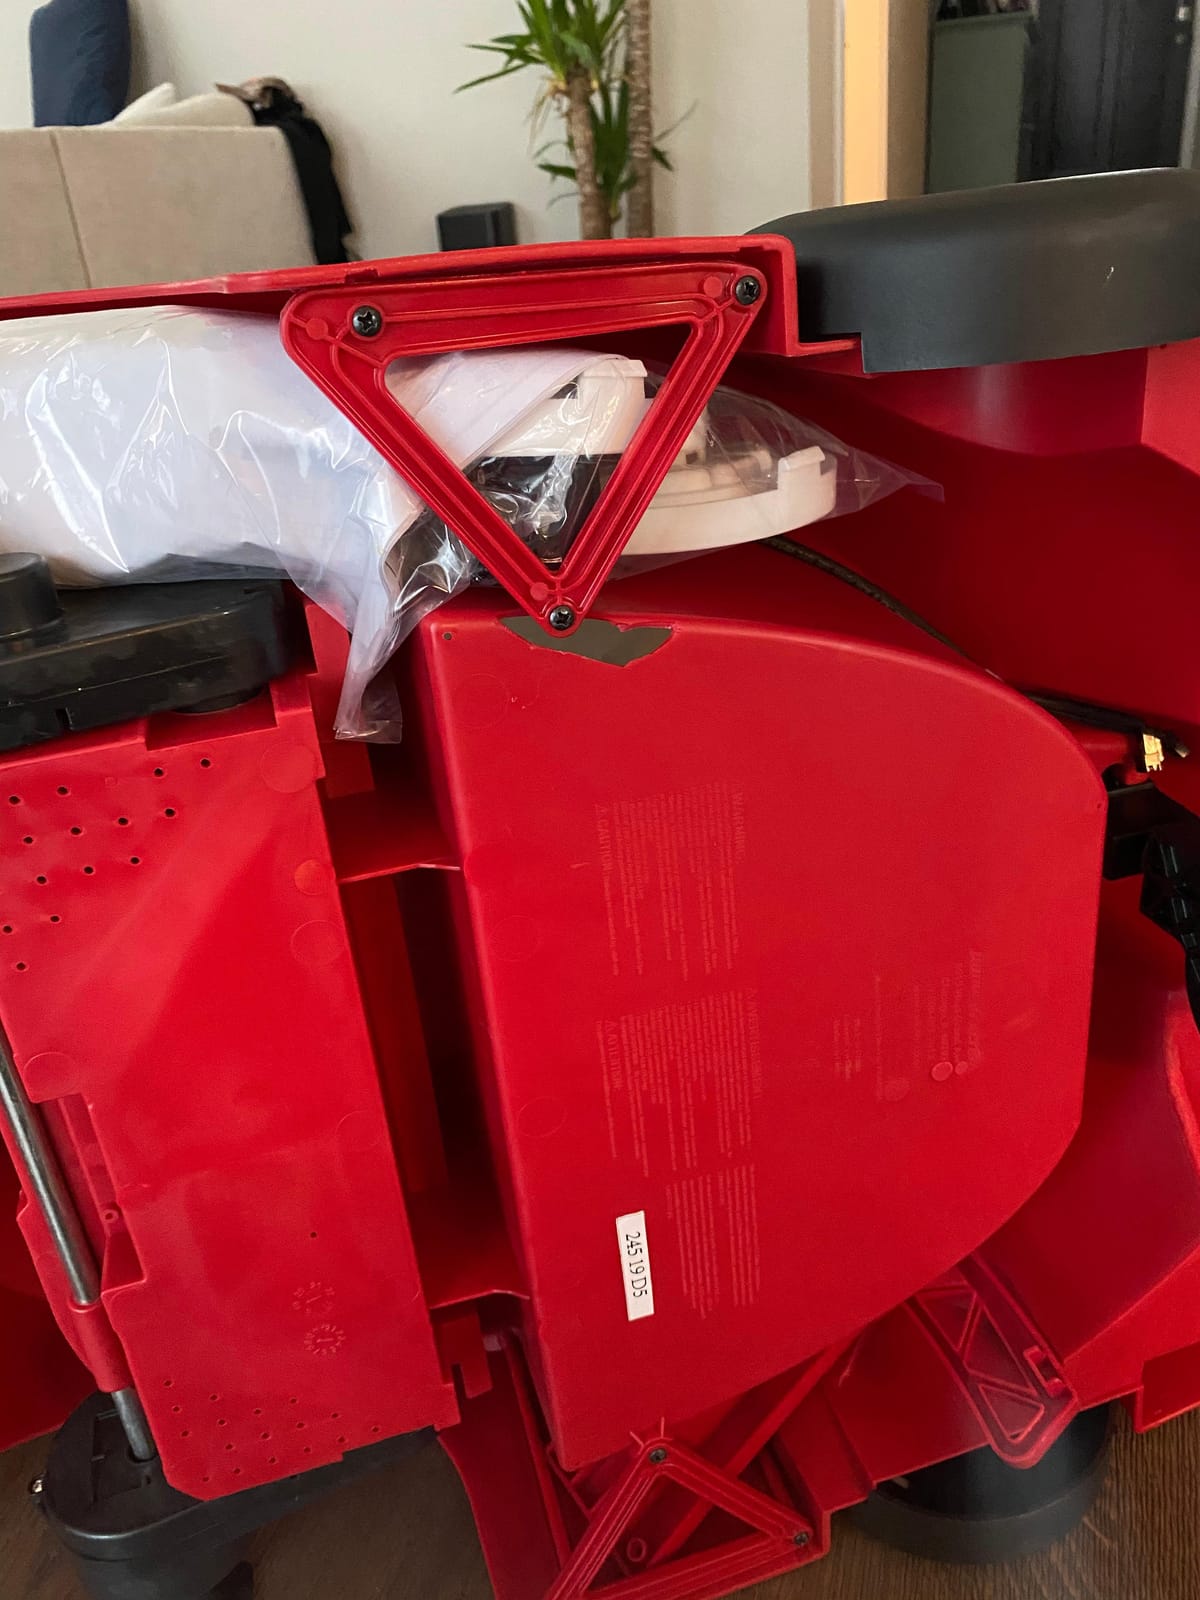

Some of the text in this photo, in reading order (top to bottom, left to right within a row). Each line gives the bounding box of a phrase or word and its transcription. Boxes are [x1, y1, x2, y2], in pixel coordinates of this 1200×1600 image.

[625, 1231, 648, 1298] 245 19 D5
